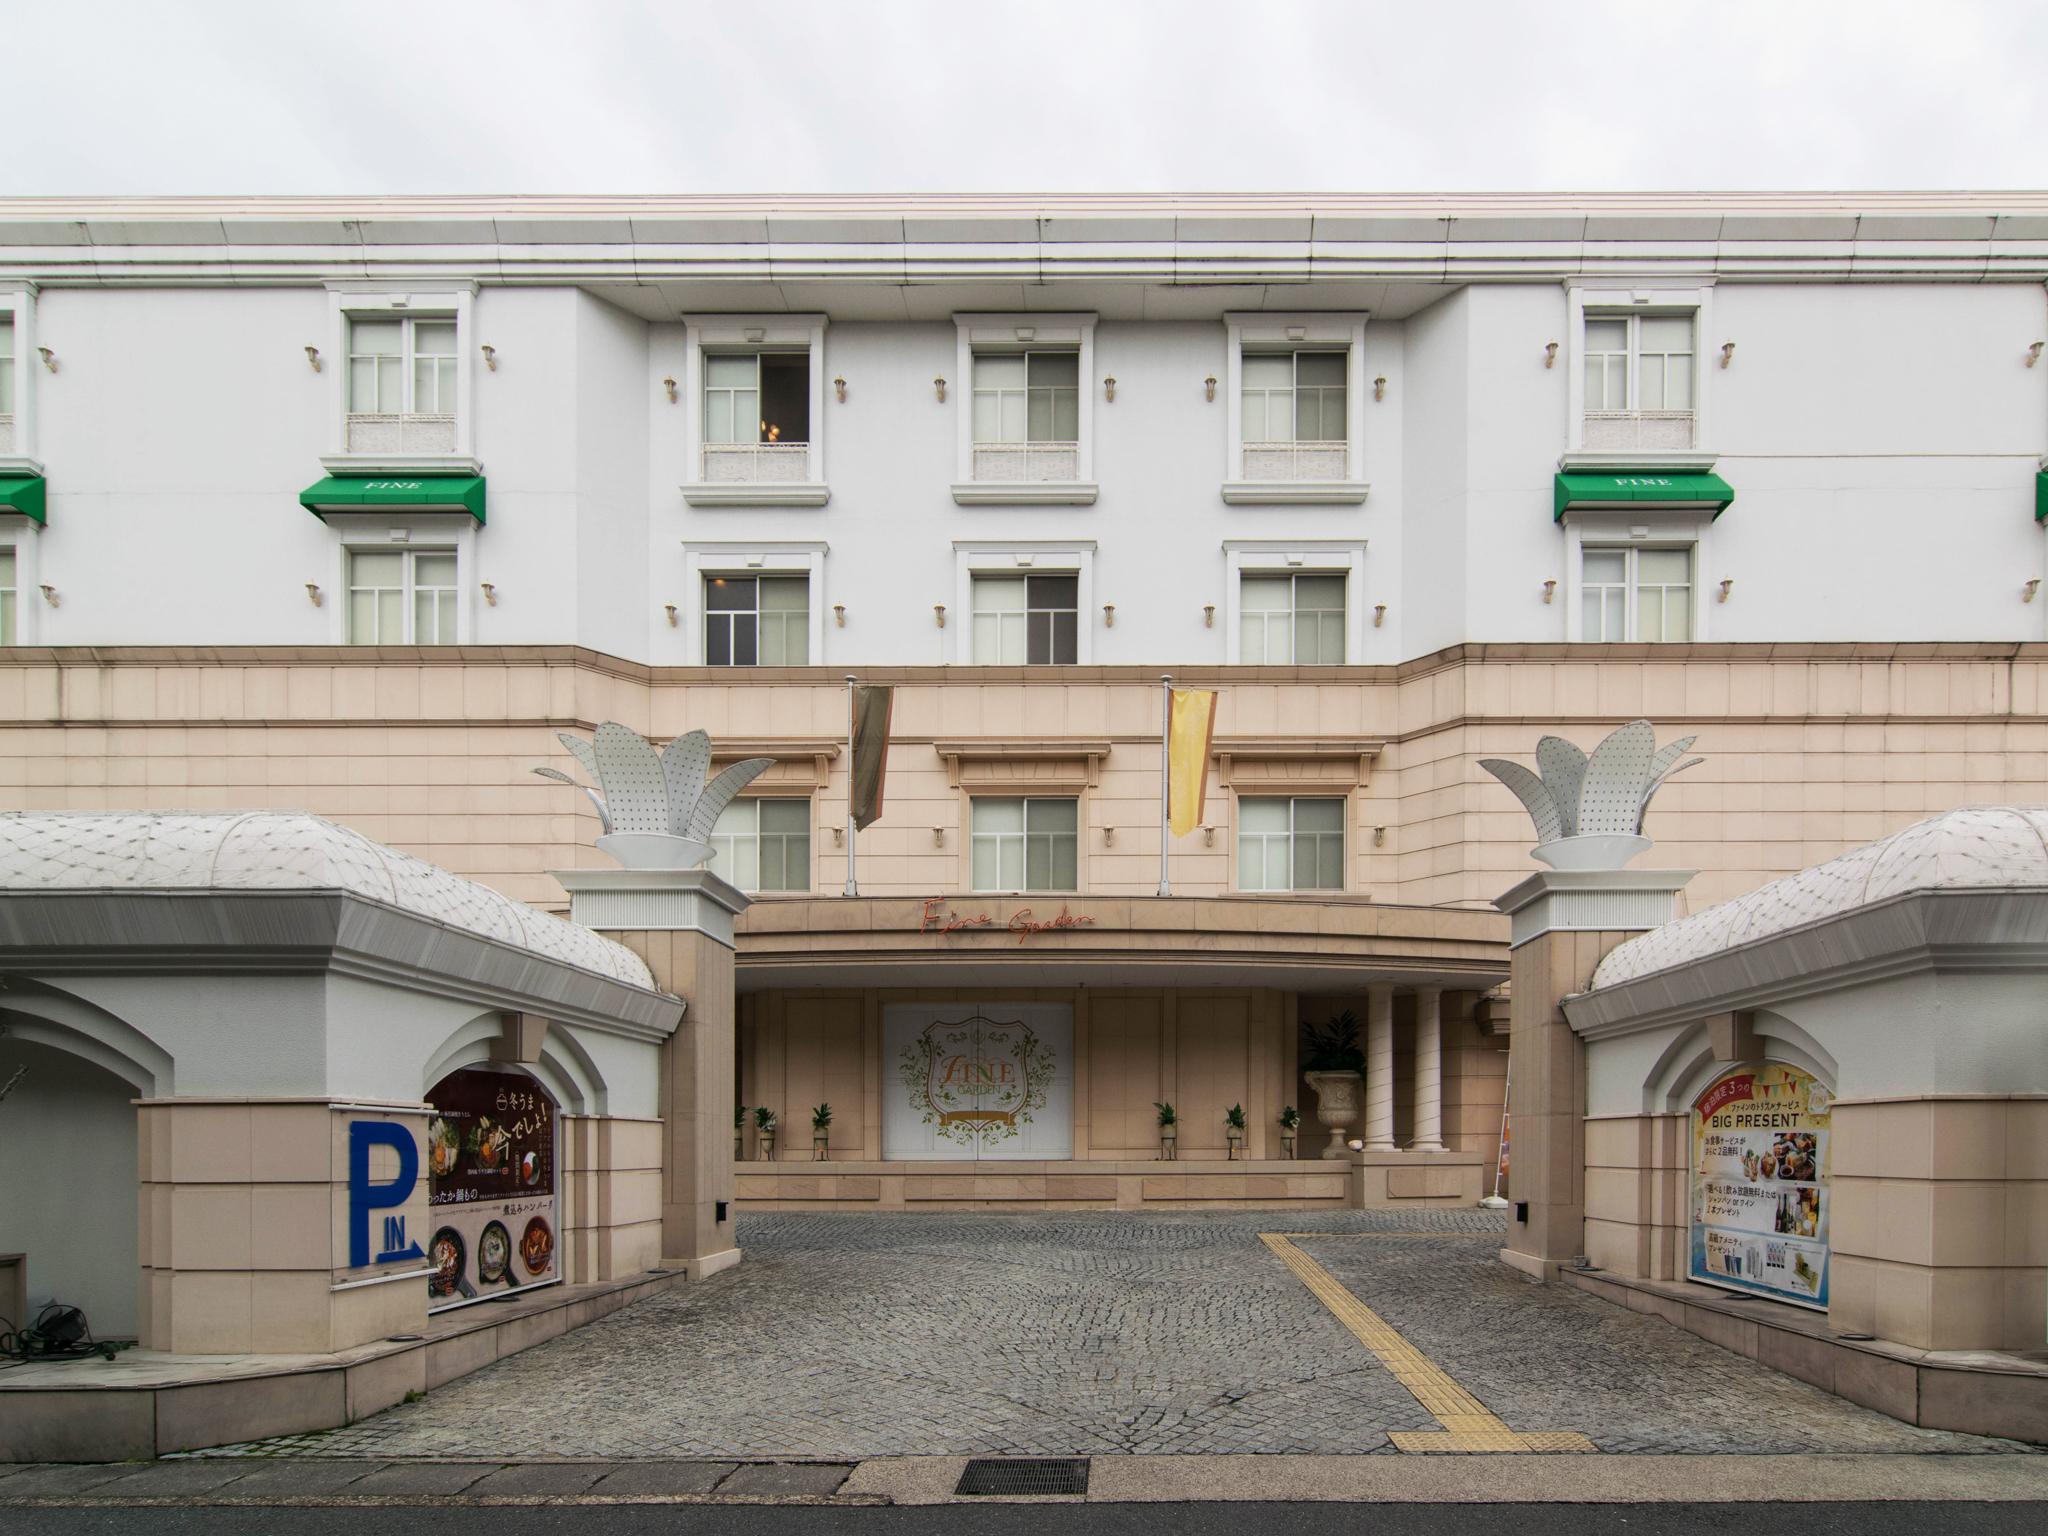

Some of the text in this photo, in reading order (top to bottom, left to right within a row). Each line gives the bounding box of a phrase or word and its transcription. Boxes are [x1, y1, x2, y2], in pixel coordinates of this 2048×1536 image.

[1614, 478, 1672, 486] FINE
[920, 897, 992, 936] Fine
[938, 1054, 1015, 1084] FINE
[509, 1092, 534, 1110] 冬うま
[957, 1084, 1001, 1095] GARDEN
[1712, 1113, 1799, 1128] BIG PRESENT
[350, 1121, 419, 1268] P
[384, 1215, 405, 1250] IN
